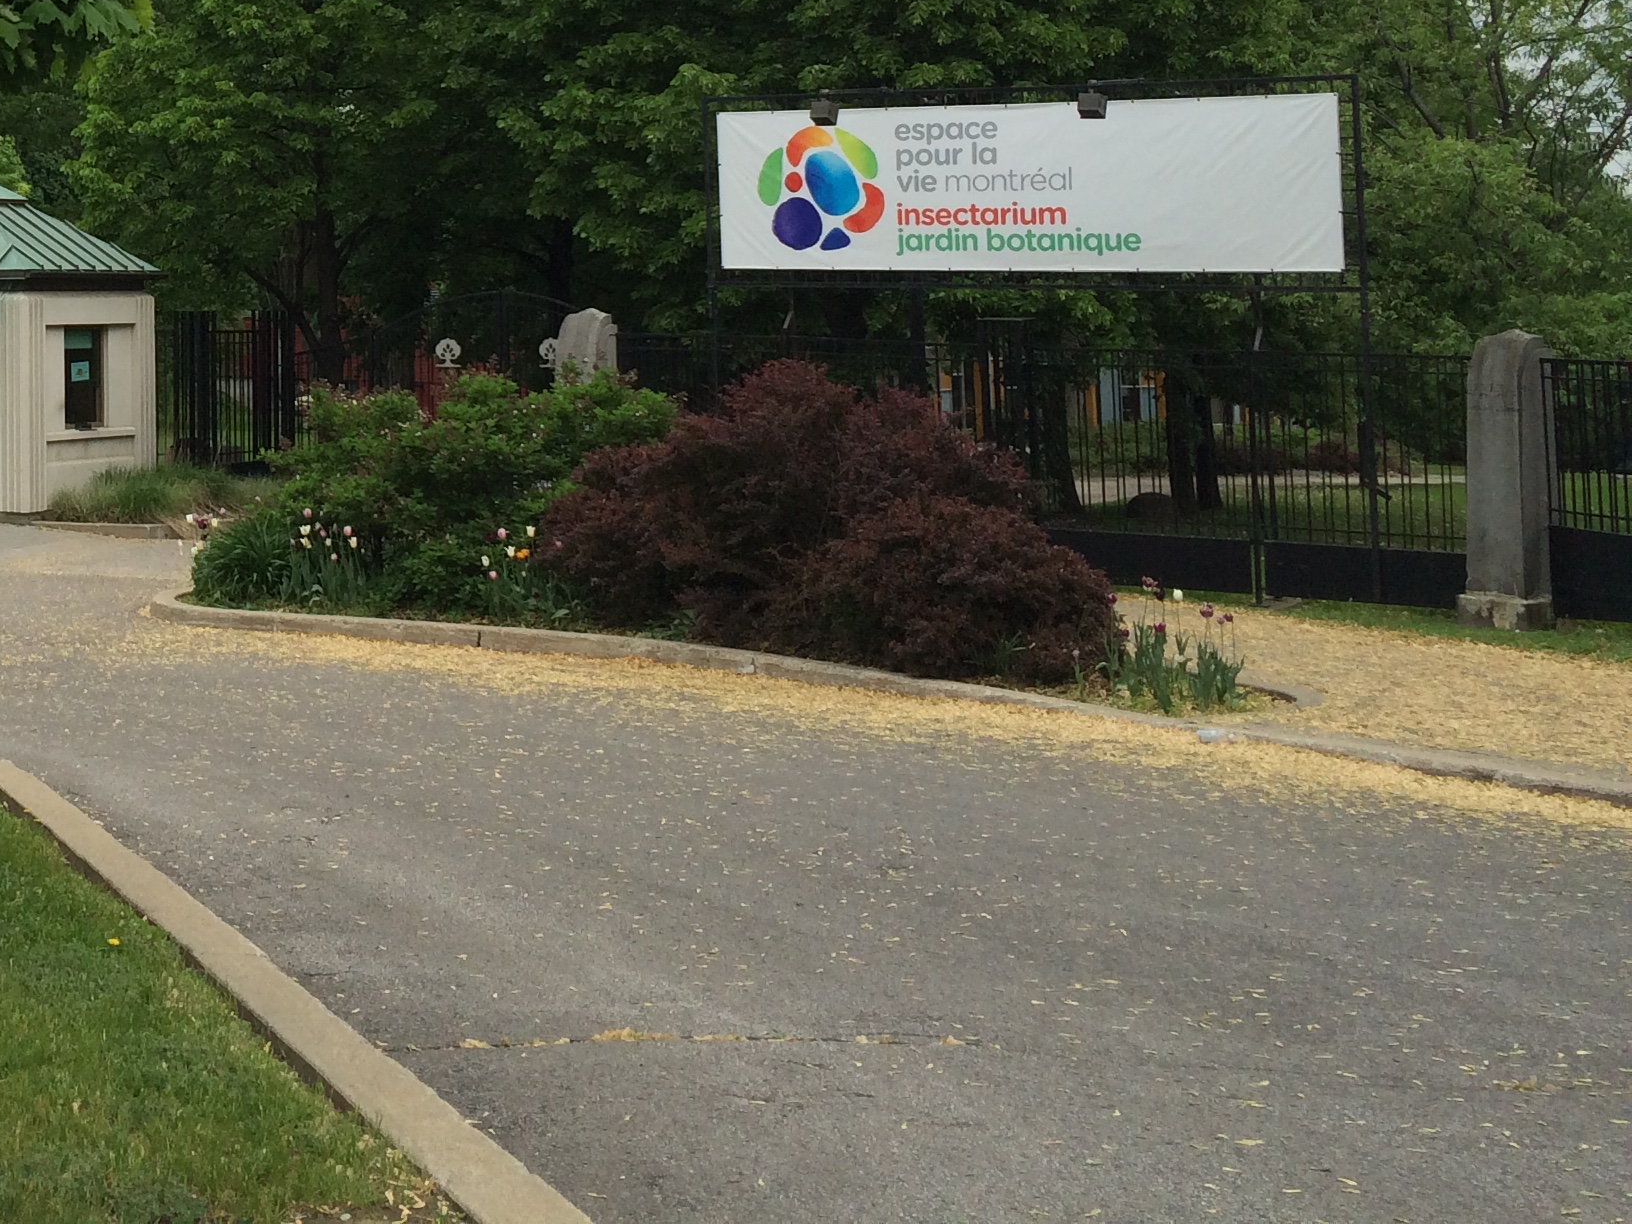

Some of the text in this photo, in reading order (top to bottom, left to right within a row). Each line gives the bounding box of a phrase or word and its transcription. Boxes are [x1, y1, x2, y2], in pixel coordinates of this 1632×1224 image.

[894, 121, 998, 145] espace
[896, 142, 998, 171] pour la
[896, 166, 1073, 193] vie montréal
[896, 201, 1067, 226] insectarium
[896, 227, 1142, 256] jardin botanique
